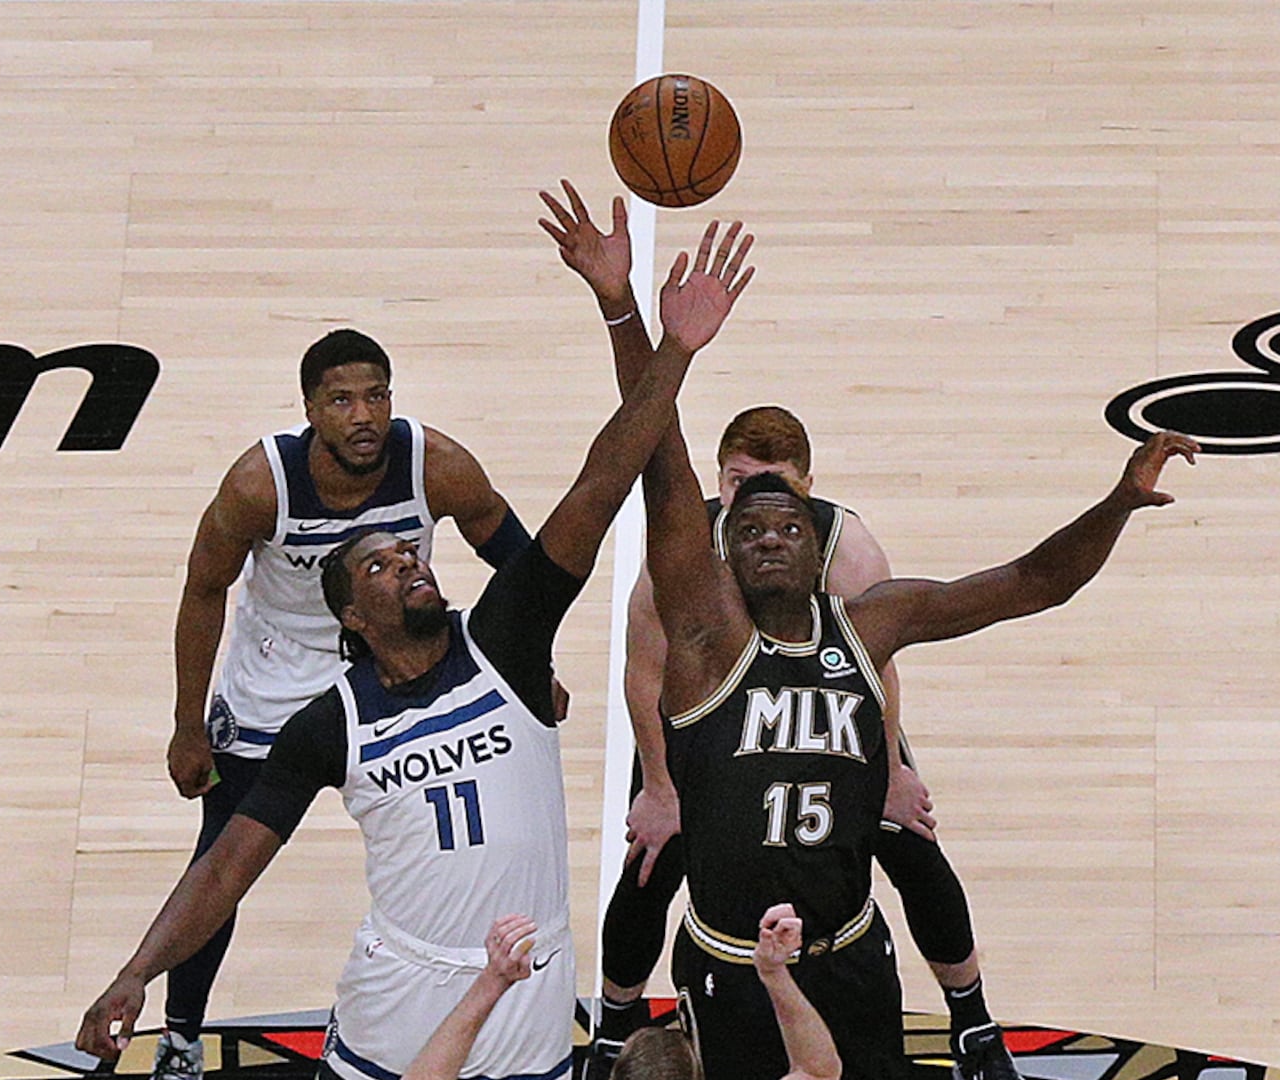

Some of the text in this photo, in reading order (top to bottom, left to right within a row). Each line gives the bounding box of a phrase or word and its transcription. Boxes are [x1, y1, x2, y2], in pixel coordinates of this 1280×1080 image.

[367, 724, 512, 794] WOLVES
[733, 686, 868, 764] MLK
[424, 779, 485, 851] 11
[762, 781, 834, 847] 15
